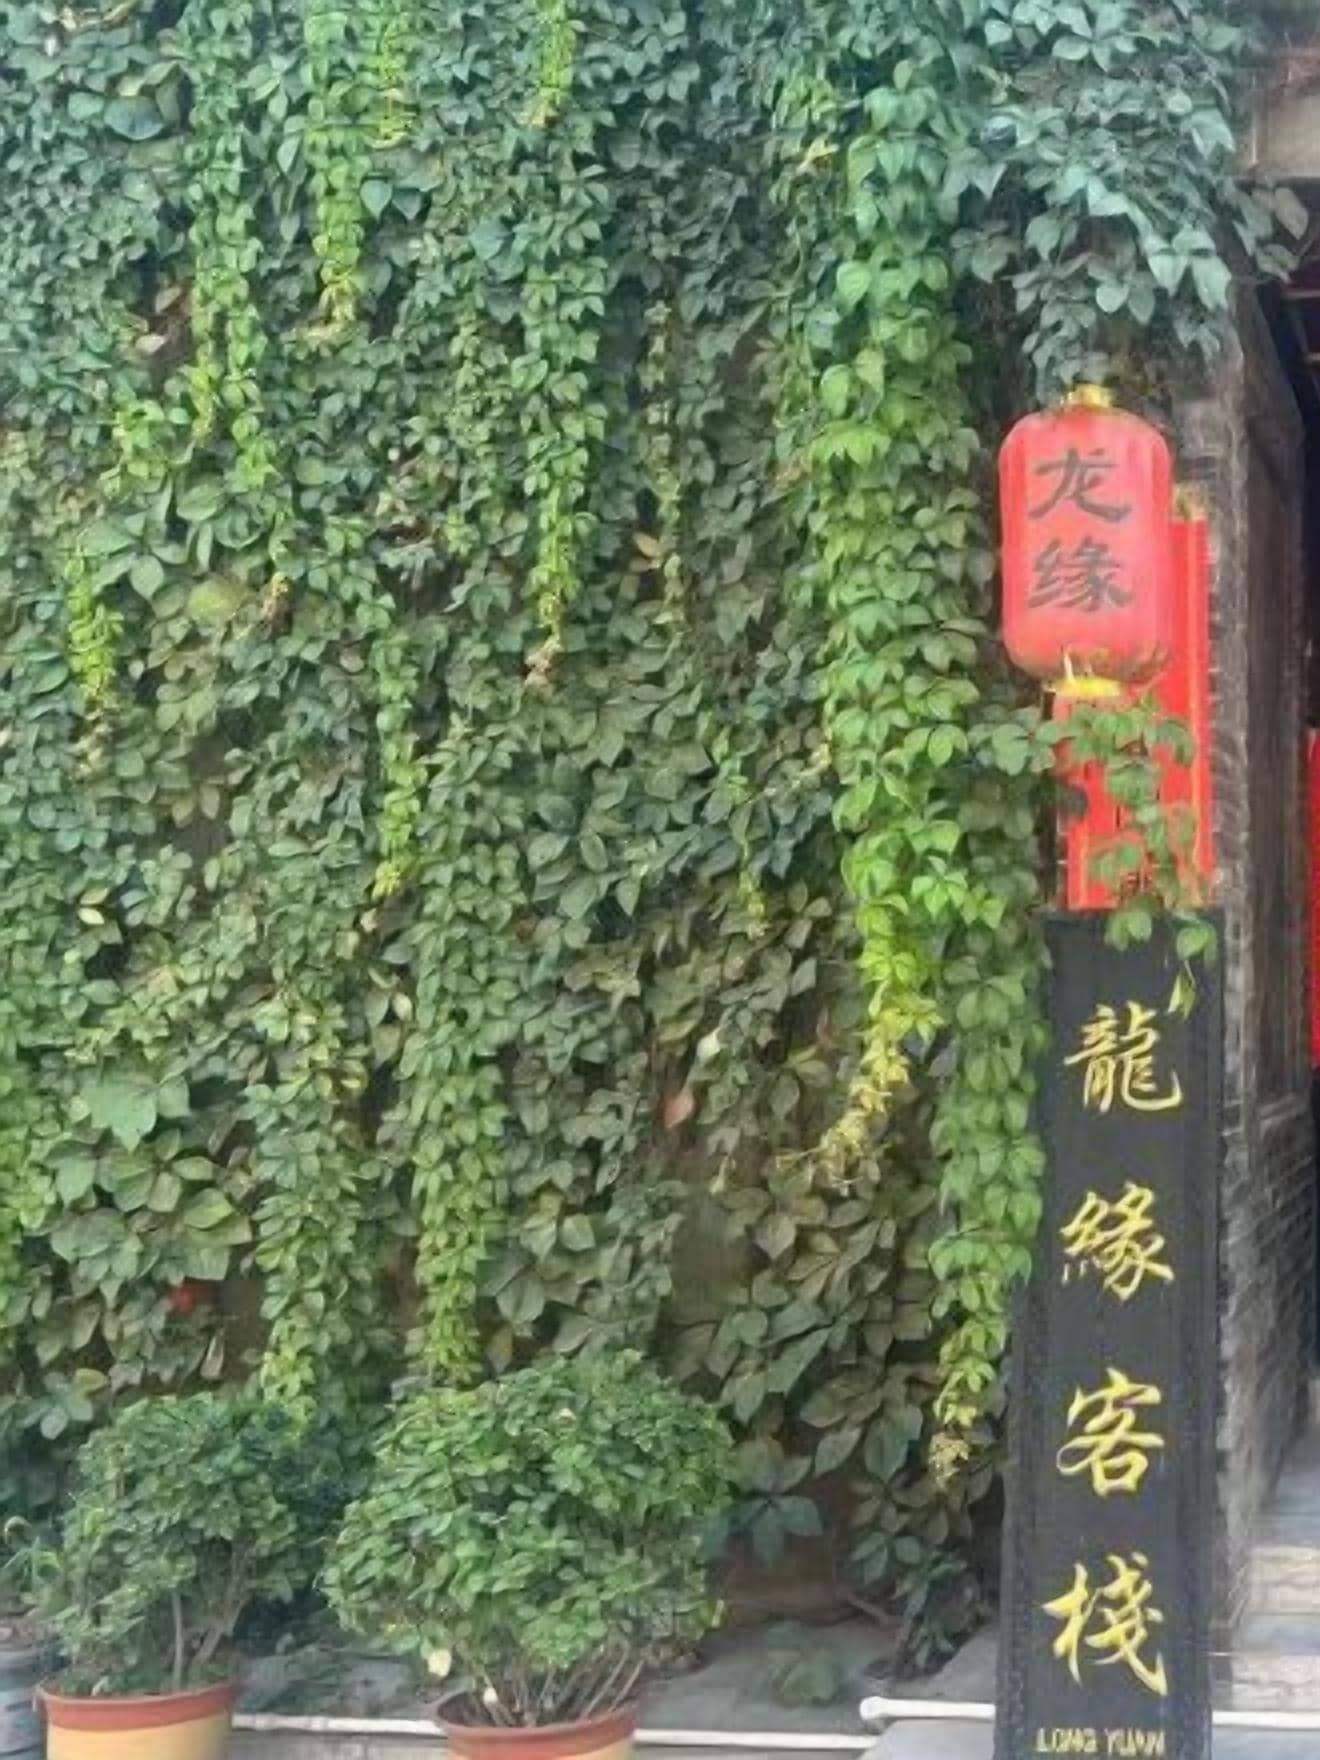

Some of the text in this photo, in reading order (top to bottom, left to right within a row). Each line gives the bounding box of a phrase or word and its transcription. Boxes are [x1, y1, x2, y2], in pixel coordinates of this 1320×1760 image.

[1025, 446, 1134, 612] 龙缘
[1041, 1001, 1183, 1699] 龍緣客棧
[1036, 1727, 1167, 1758] LONG YUAN
